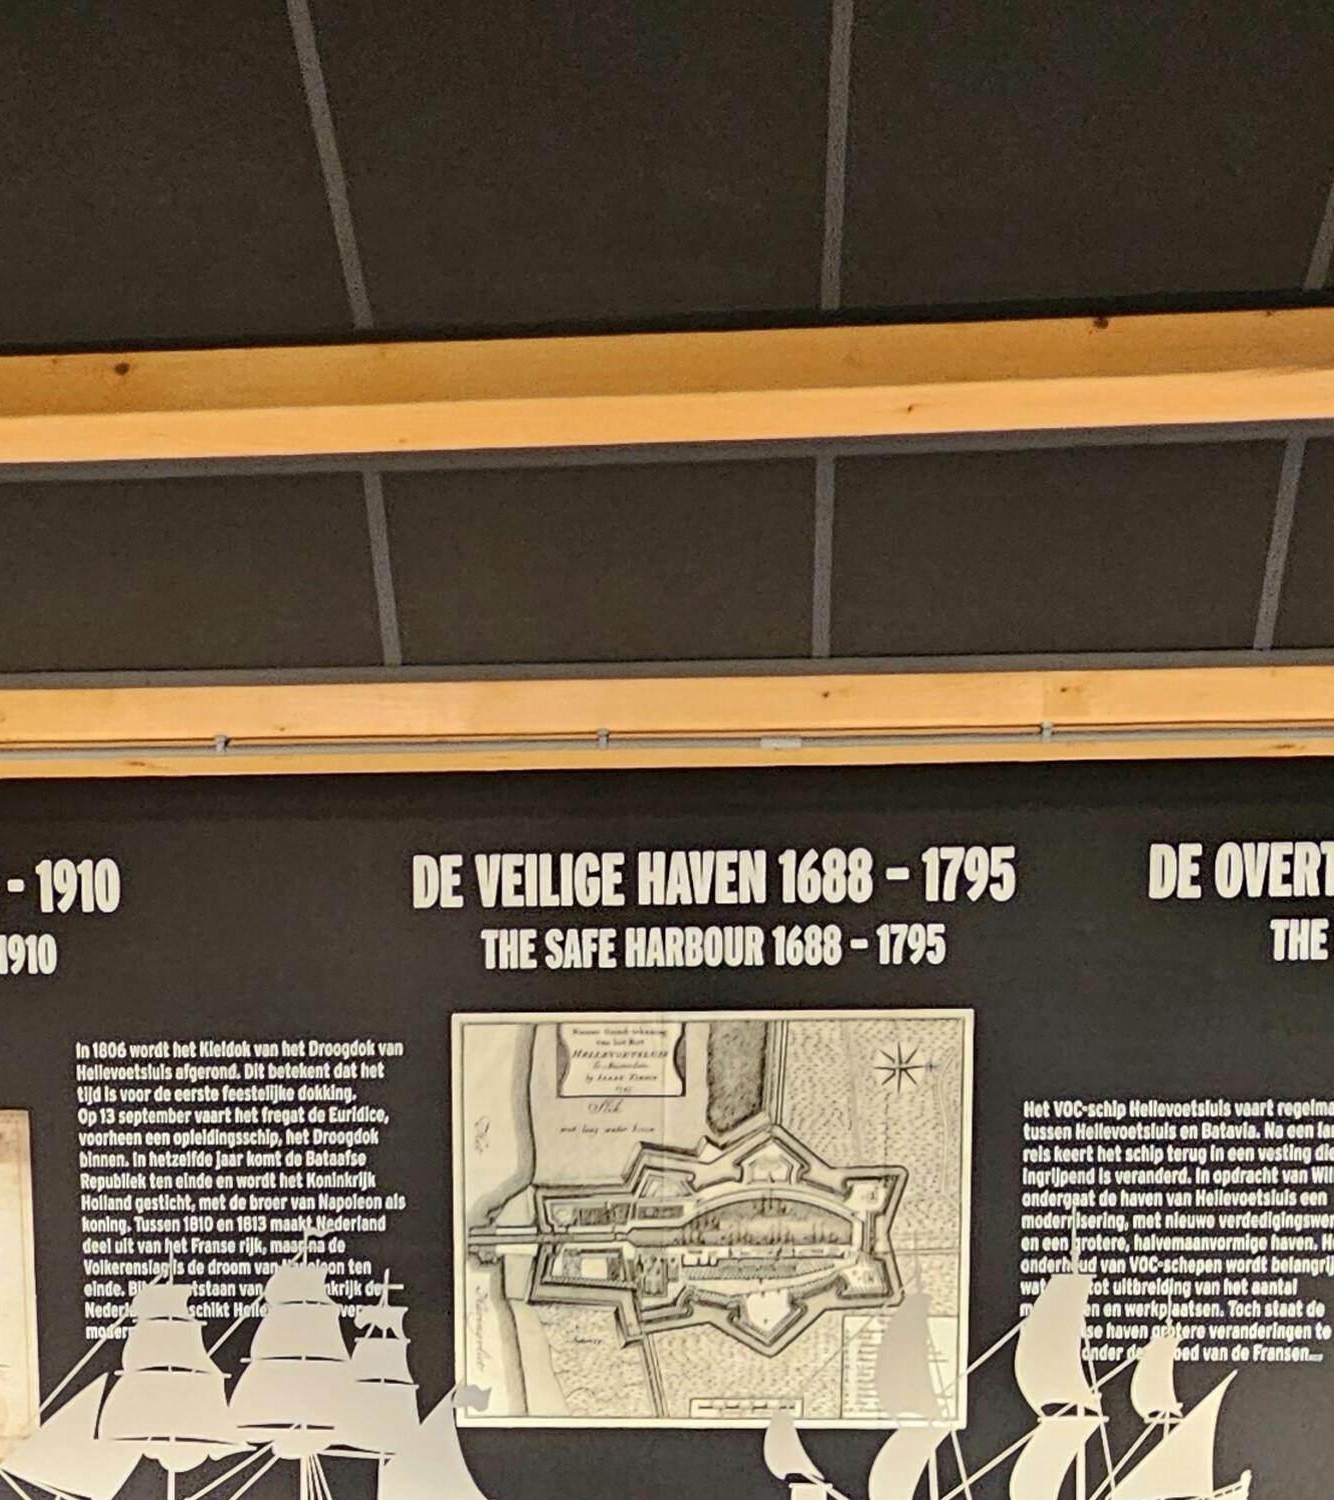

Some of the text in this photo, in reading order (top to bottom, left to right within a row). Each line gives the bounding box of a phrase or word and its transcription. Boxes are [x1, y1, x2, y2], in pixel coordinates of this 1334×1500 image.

[412, 855, 464, 908] DE
[474, 854, 625, 907] VEILIGE
[638, 851, 767, 904] HAVEN
[778, 848, 873, 903] 1688
[921, 847, 1016, 901] 1795
[1148, 844, 1203, 898] DE
[35, 859, 121, 912] 1910
[480, 929, 538, 968] THE
[544, 929, 617, 968] SAFE
[625, 927, 765, 966] HARBOUR
[772, 925, 842, 965] 1688
[875, 924, 946, 964] 1795
[1270, 919, 1329, 960] THE
[75, 1039, 404, 1059] In 1806 wordt het Kieldok van het Droogdok van
[175, 1063, 241, 1082] afgerond.
[244, 1062, 265, 1079] Dit
[267, 1062, 331, 1079] betekent
[333, 1061, 358, 1078] dat
[360, 1061, 385, 1078] het
[77, 1085, 102, 1105] tijd
[104, 1085, 117, 1101] is
[119, 1088, 152, 1101] voor
[153, 1085, 172, 1101] de
[174, 1085, 220, 1101] eerste
[297, 1084, 357, 1103] dokking.
[77, 1105, 389, 1126] Op 13 september vaart het fregat de Euridice,
[1023, 1100, 1050, 1118] Het
[1053, 1099, 1127, 1119] VOC-schip
[1234, 1099, 1274, 1117] vaart
[1023, 1123, 1072, 1140] tussen
[1179, 1124, 1198, 1139] en
[1201, 1121, 1261, 1138] Batavia.
[1264, 1121, 1284, 1138] Na
[1286, 1124, 1315, 1138] een
[1022, 1144, 1051, 1162] reis
[1054, 1145, 1094, 1161] keert
[1097, 1144, 1122, 1161] het
[1125, 1144, 1164, 1164] schip
[1166, 1144, 1207, 1165] terug
[1210, 1144, 1225, 1162] in
[1227, 1146, 1255, 1161] een
[1257, 1143, 1312, 1164] vesting
[1098, 1166, 1112, 1184] is
[1195, 1167, 1210, 1183] In
[1212, 1166, 1279, 1186] opdracht
[1281, 1168, 1308, 1183] van
